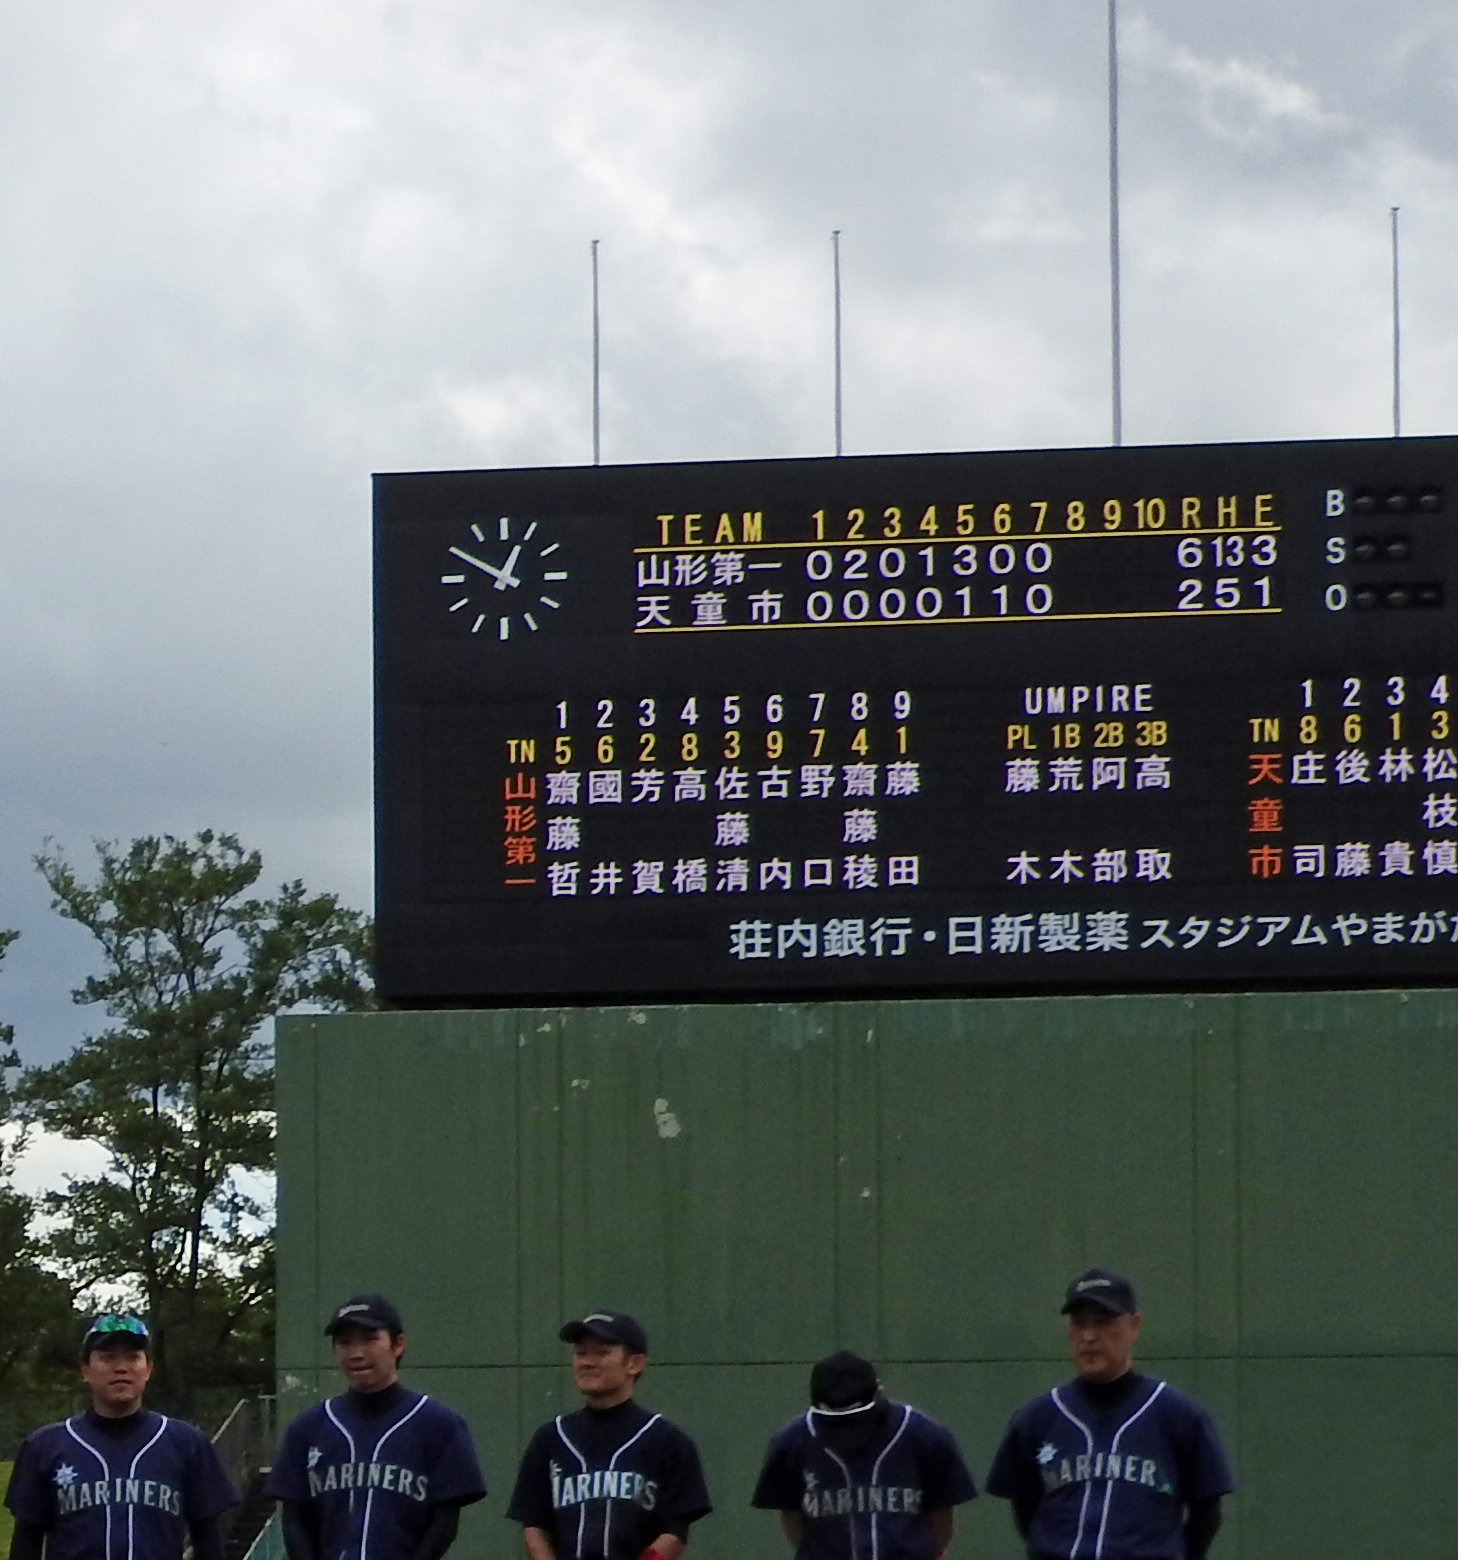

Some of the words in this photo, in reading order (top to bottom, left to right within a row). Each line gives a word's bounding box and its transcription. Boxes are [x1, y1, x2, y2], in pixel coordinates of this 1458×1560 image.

[656, 512, 763, 545] TEAM
[812, 510, 824, 540] 1
[847, 508, 865, 539] 2
[883, 507, 902, 537] 3
[919, 506, 939, 535] 4
[956, 504, 975, 535] 5
[993, 503, 1012, 534] 6
[1030, 502, 1048, 533] 7
[1066, 500, 1086, 531] 8
[1103, 499, 1122, 530] 9
[1133, 498, 1166, 529] 10
[1182, 498, 1201, 529] R
[1217, 496, 1237, 528] H
[1255, 494, 1274, 526] E
[1326, 489, 1345, 517] B
[638, 551, 783, 588] 山形第一
[1326, 537, 1346, 564] S
[636, 589, 784, 628] 天童市
[556, 701, 567, 729] 1
[596, 700, 614, 728] 2
[638, 698, 656, 727] 3
[680, 697, 699, 726] 4
[723, 695, 741, 724] 5
[766, 694, 784, 723] 6
[808, 693, 826, 722] 7
[850, 692, 869, 721] 8
[893, 691, 911, 720] 9
[1025, 683, 1154, 715] UMPIRE
[1301, 679, 1313, 708] 1
[1342, 677, 1361, 707] 2
[1386, 676, 1405, 706] 3
[1429, 674, 1449, 704] 4
[506, 739, 535, 764] TN
[555, 736, 572, 765] 5
[597, 735, 614, 764] 6
[638, 733, 656, 762] 2
[681, 733, 699, 762] 8
[723, 731, 741, 759] 3
[766, 730, 783, 759] 9
[809, 728, 826, 758] 7
[850, 727, 869, 756] 4
[896, 726, 907, 754] 1
[1007, 724, 1037, 750] PL
[1051, 723, 1081, 749] 1B
[1093, 722, 1124, 748] 2B
[1136, 720, 1167, 747] 3B
[1249, 718, 1279, 743] TN
[1299, 715, 1318, 744] 8
[1343, 714, 1362, 743] 6
[1389, 712, 1400, 741] 1
[1431, 710, 1449, 740] 3
[503, 772, 537, 886] 山形第一
[1247, 753, 1283, 879] 天童市
[1140, 910, 1458, 950] スタジアムやまが
[56, 1477, 181, 1516] MARINERS
